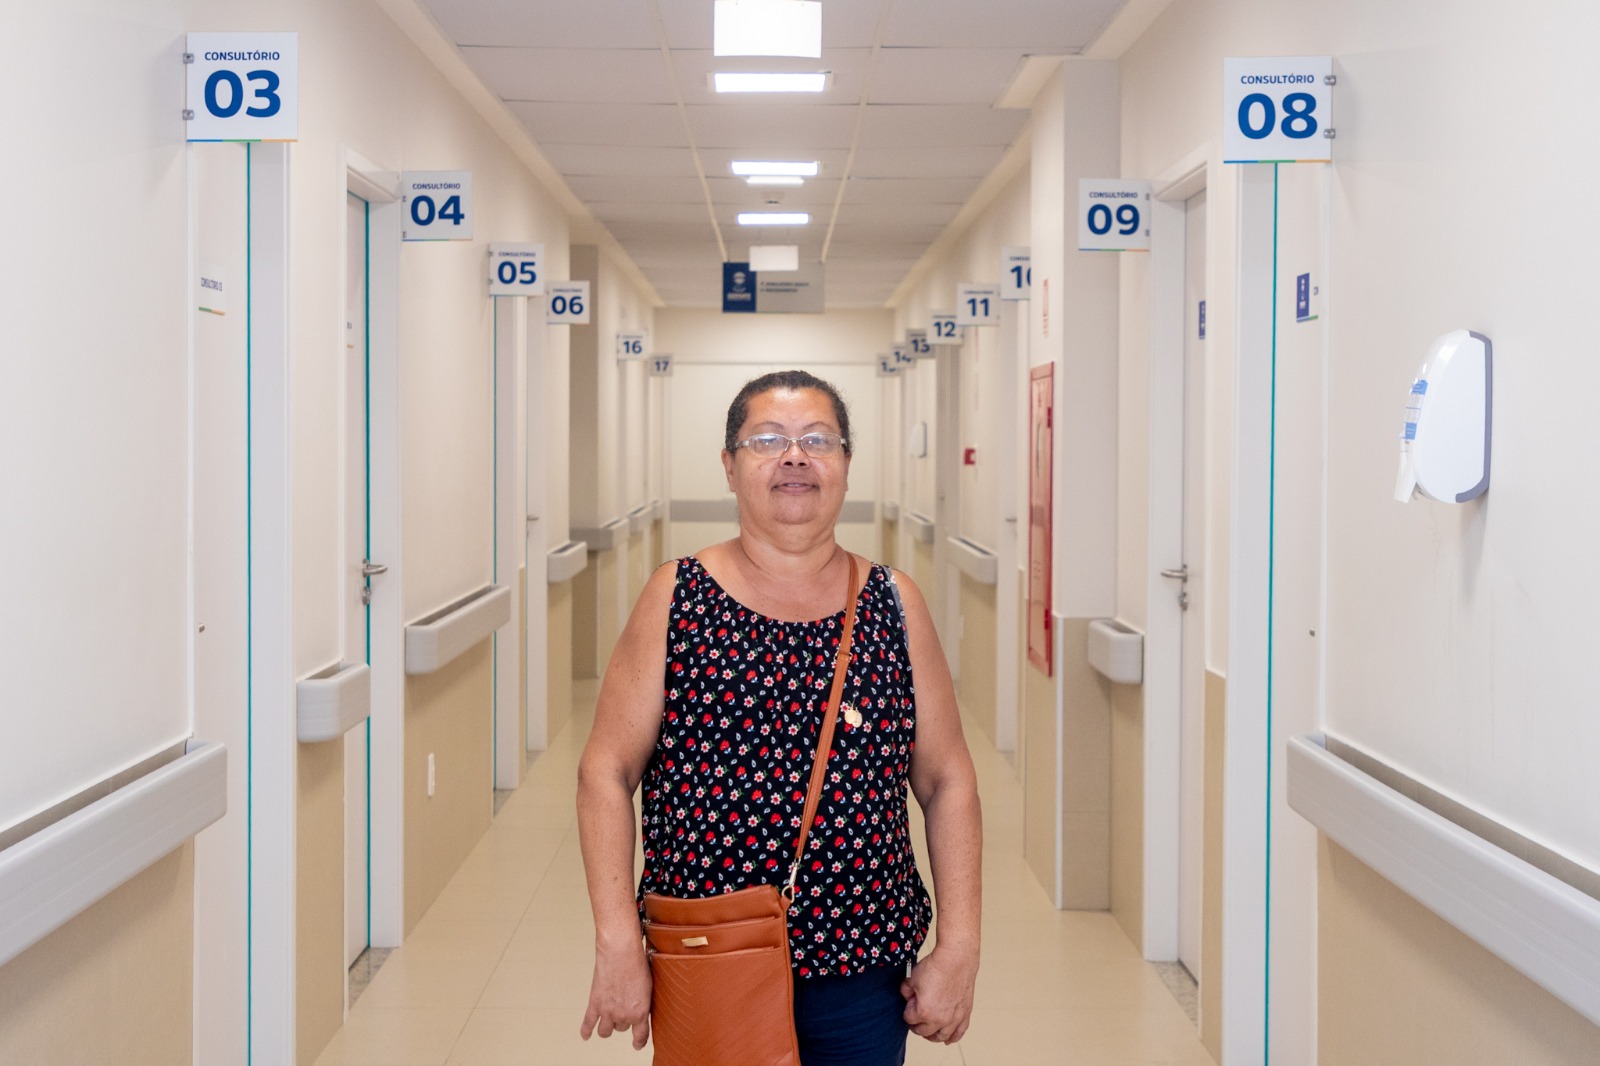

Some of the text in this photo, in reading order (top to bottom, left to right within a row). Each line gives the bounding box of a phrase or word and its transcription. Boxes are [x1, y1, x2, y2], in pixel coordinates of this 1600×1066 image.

[204, 50, 281, 61] CONSULTÓRIO
[1240, 73, 1315, 85] CONSULTÓRIO
[204, 69, 282, 119] 03
[1237, 92, 1318, 140] 08
[412, 182, 461, 190] CONSULTÓRIO
[1089, 190, 1139, 199] CONSULTÓRIO
[410, 195, 465, 226] 04
[1087, 203, 1140, 236] 09
[497, 261, 537, 285] 05
[1010, 265, 1031, 289] 1
[551, 295, 584, 315] 06
[967, 297, 990, 317] 11
[933, 321, 956, 337] 12
[623, 340, 643, 354] 16
[911, 338, 931, 353] 13
[655, 360, 669, 372] 17
[881, 361, 897, 373] 1
